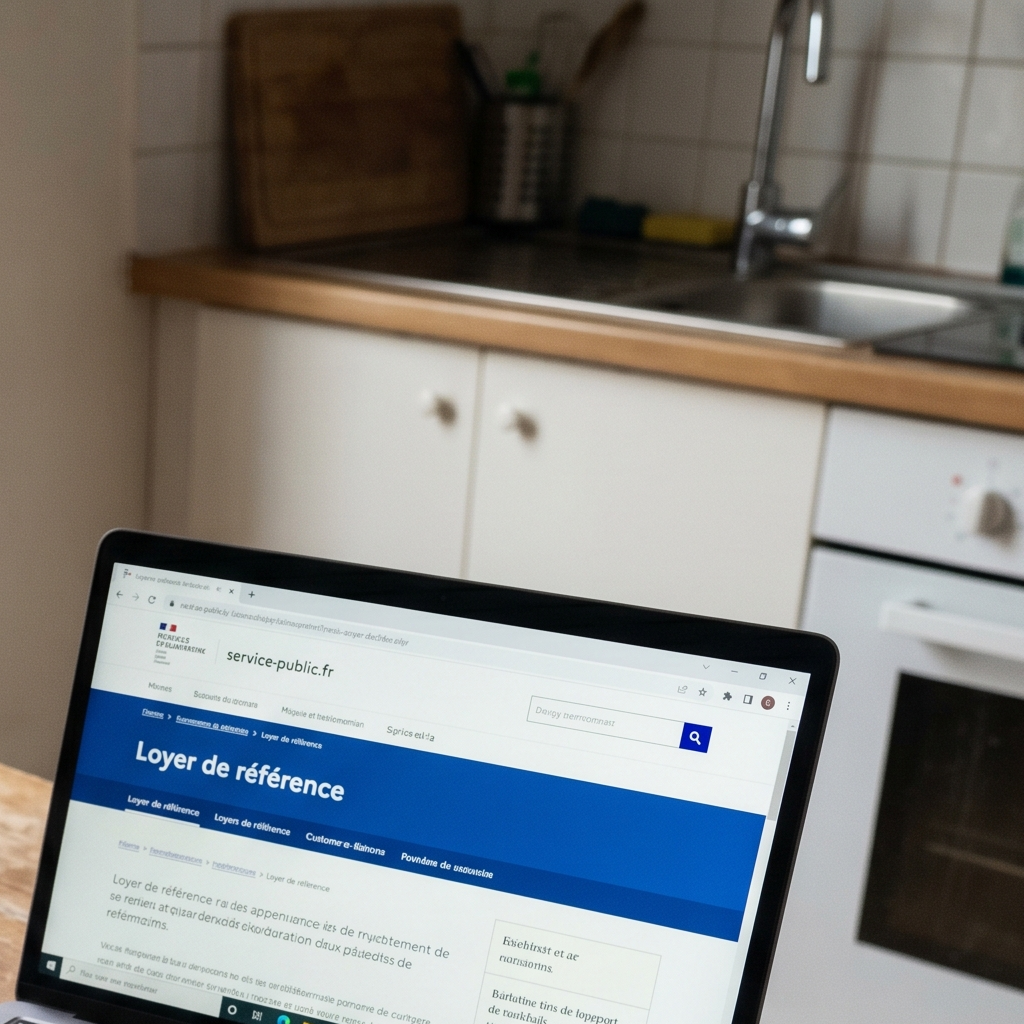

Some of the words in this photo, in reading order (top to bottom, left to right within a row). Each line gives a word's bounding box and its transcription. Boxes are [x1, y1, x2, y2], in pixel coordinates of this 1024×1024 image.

[226, 649, 334, 679] service-public.fr
[135, 740, 197, 771] Loyer
[201, 755, 230, 778] de
[236, 762, 345, 801] référence
[241, 818, 251, 828] de
[440, 860, 451, 870] de
[112, 874, 142, 889] Loyer
[145, 882, 159, 893] de
[162, 886, 212, 905] référence
[230, 902, 248, 913] des
[340, 926, 355, 937] de
[434, 947, 450, 959] de
[110, 893, 121, 902] se
[397, 958, 413, 970] de
[554, 950, 564, 958] et
[377, 1007, 389, 1017] de
[488, 1005, 500, 1015] de
[560, 1006, 573, 1017] de
